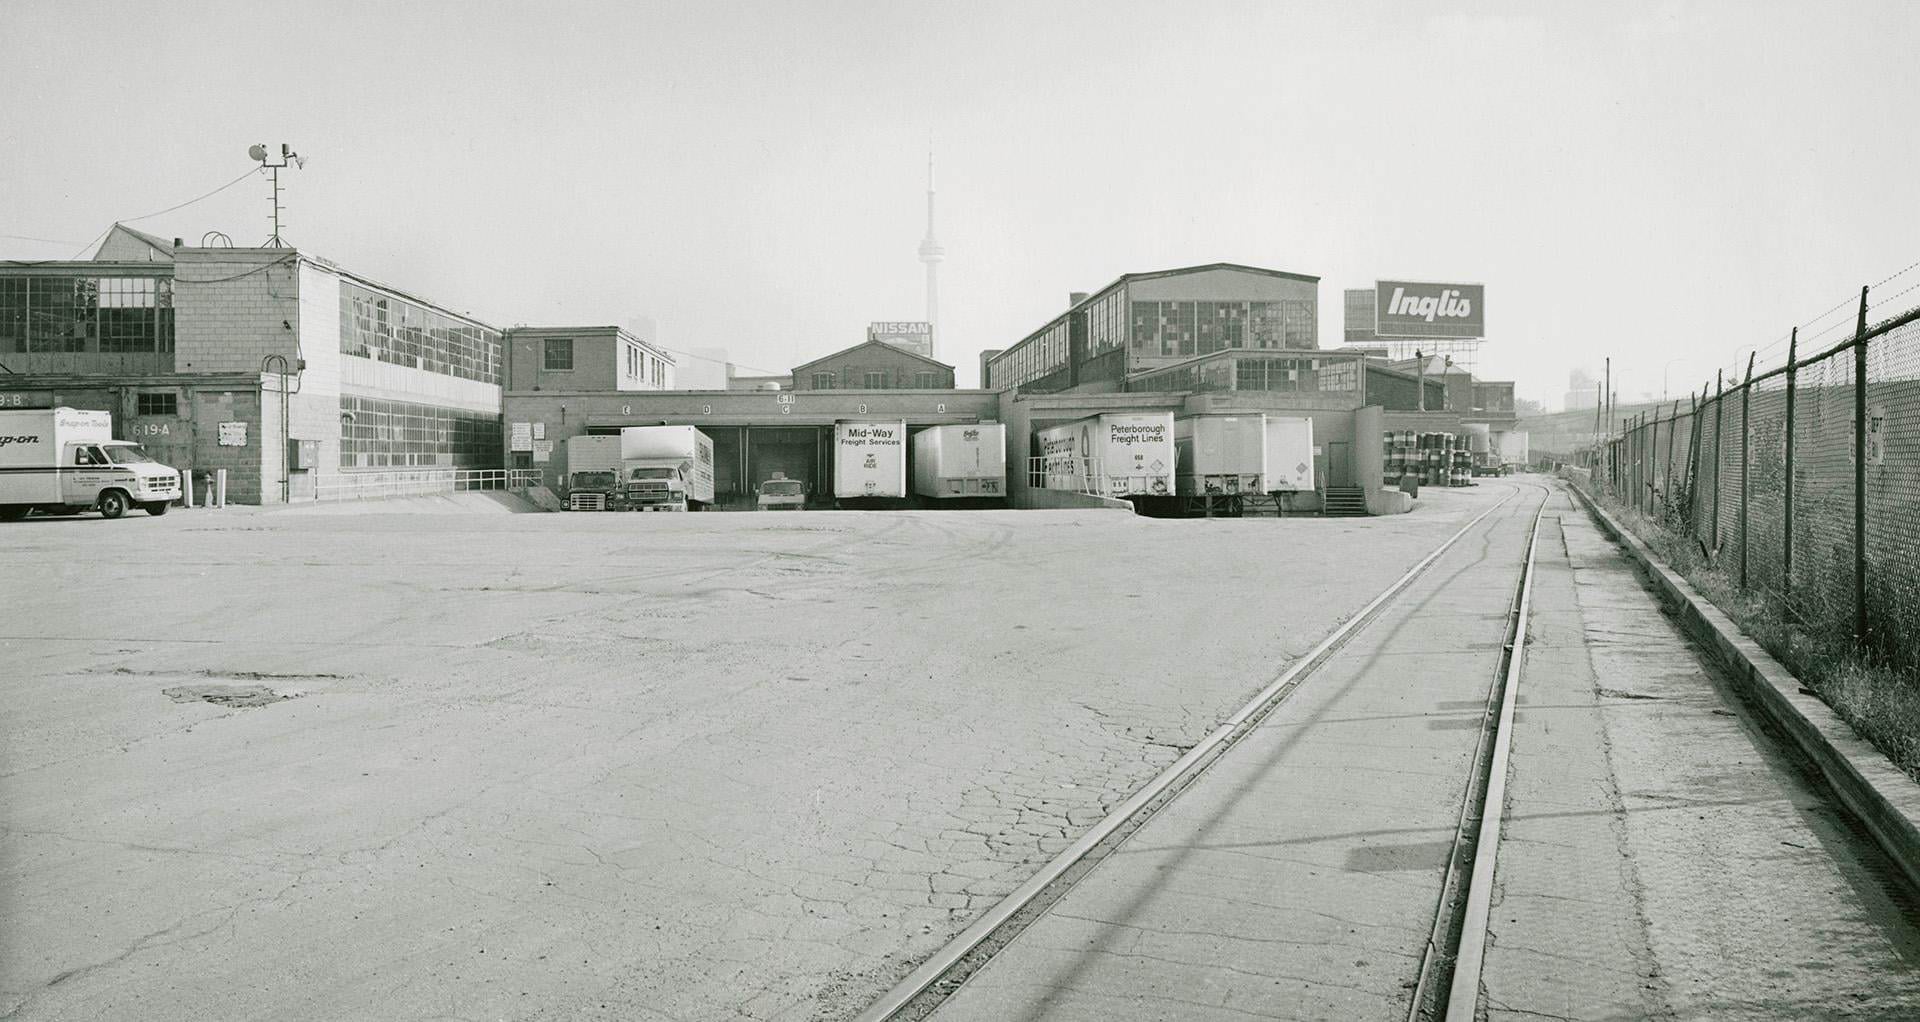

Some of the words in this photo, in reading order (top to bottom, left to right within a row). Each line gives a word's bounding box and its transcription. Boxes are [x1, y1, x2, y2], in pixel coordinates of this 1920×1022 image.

[1388, 287, 1471, 322] Inglis
[872, 322, 929, 334] NISSAN
[859, 404, 867, 414] B
[938, 404, 945, 414] A
[848, 429, 893, 438] Mid-Way
[1111, 424, 1165, 435] Peterborough
[869, 438, 900, 446] Services
[1111, 434, 1139, 445] Freight
[1142, 434, 1164, 443] Lines
